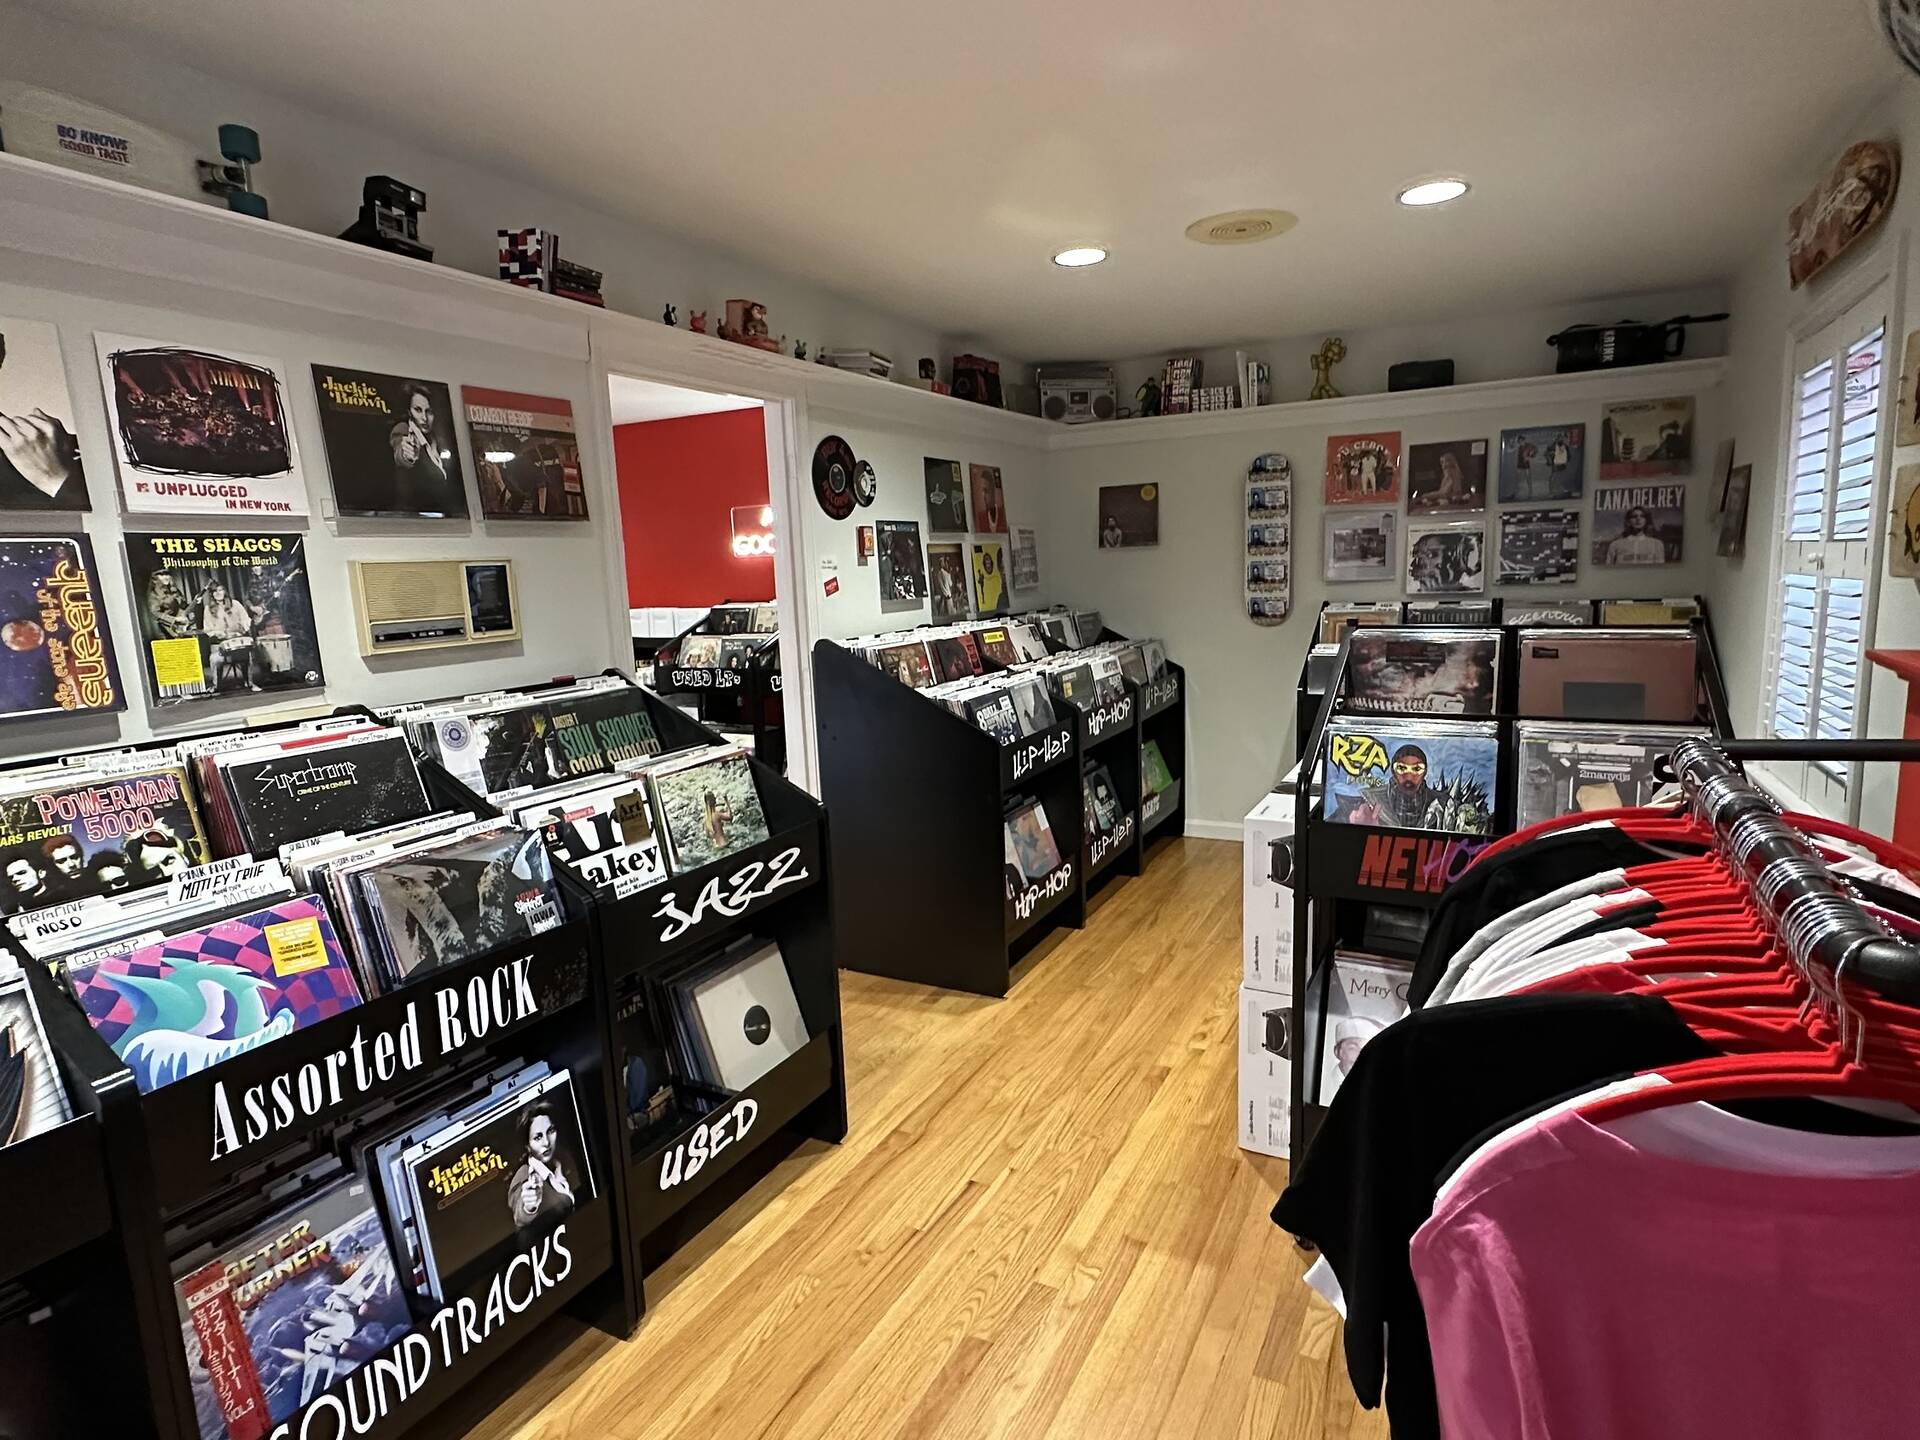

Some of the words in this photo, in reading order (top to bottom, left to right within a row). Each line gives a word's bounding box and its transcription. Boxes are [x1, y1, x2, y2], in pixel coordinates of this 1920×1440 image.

[59, 138, 95, 155] GOOD
[80, 130, 128, 151] KNOWS
[209, 369, 262, 391] NIRVANA
[322, 376, 377, 396] Jackie
[329, 391, 392, 414] Brown
[469, 406, 508, 424] COWBOY
[154, 482, 247, 498] UNPLUGGED
[1596, 490, 1631, 511] LANA
[1632, 488, 1655, 508] DEL
[1657, 486, 1684, 508] REY
[226, 499, 237, 509] IN
[240, 500, 262, 510] NEW
[263, 501, 292, 512] YORK
[151, 538, 197, 553] THE
[203, 538, 282, 553] SHAGGS
[162, 556, 219, 569] Philosophy
[221, 557, 231, 567] of
[232, 557, 249, 567] The
[251, 555, 278, 566] World
[46, 560, 113, 708] queens
[672, 669, 713, 687] USED
[558, 724, 602, 761] SOUL
[596, 712, 657, 750] SHOWER
[1331, 734, 1390, 779] RZA
[254, 758, 358, 797] Supertramp
[1579, 769, 1631, 784] 2manydjs
[32, 774, 179, 827] POWERMAN
[619, 801, 641, 816] Art
[27, 823, 73, 842] REVOLT!
[83, 806, 156, 844] 5000
[1358, 833, 1453, 893] NEW
[178, 867, 207, 883] PINK
[629, 876, 640, 886] his
[633, 874, 666, 890] Messengers
[529, 906, 556, 925] IOWA
[1350, 978, 1392, 998] Merry
[210, 1002, 423, 1162] Assorted
[435, 954, 539, 1055] ROCK
[659, 1098, 759, 1191] USED
[428, 1145, 491, 1189] Jackie
